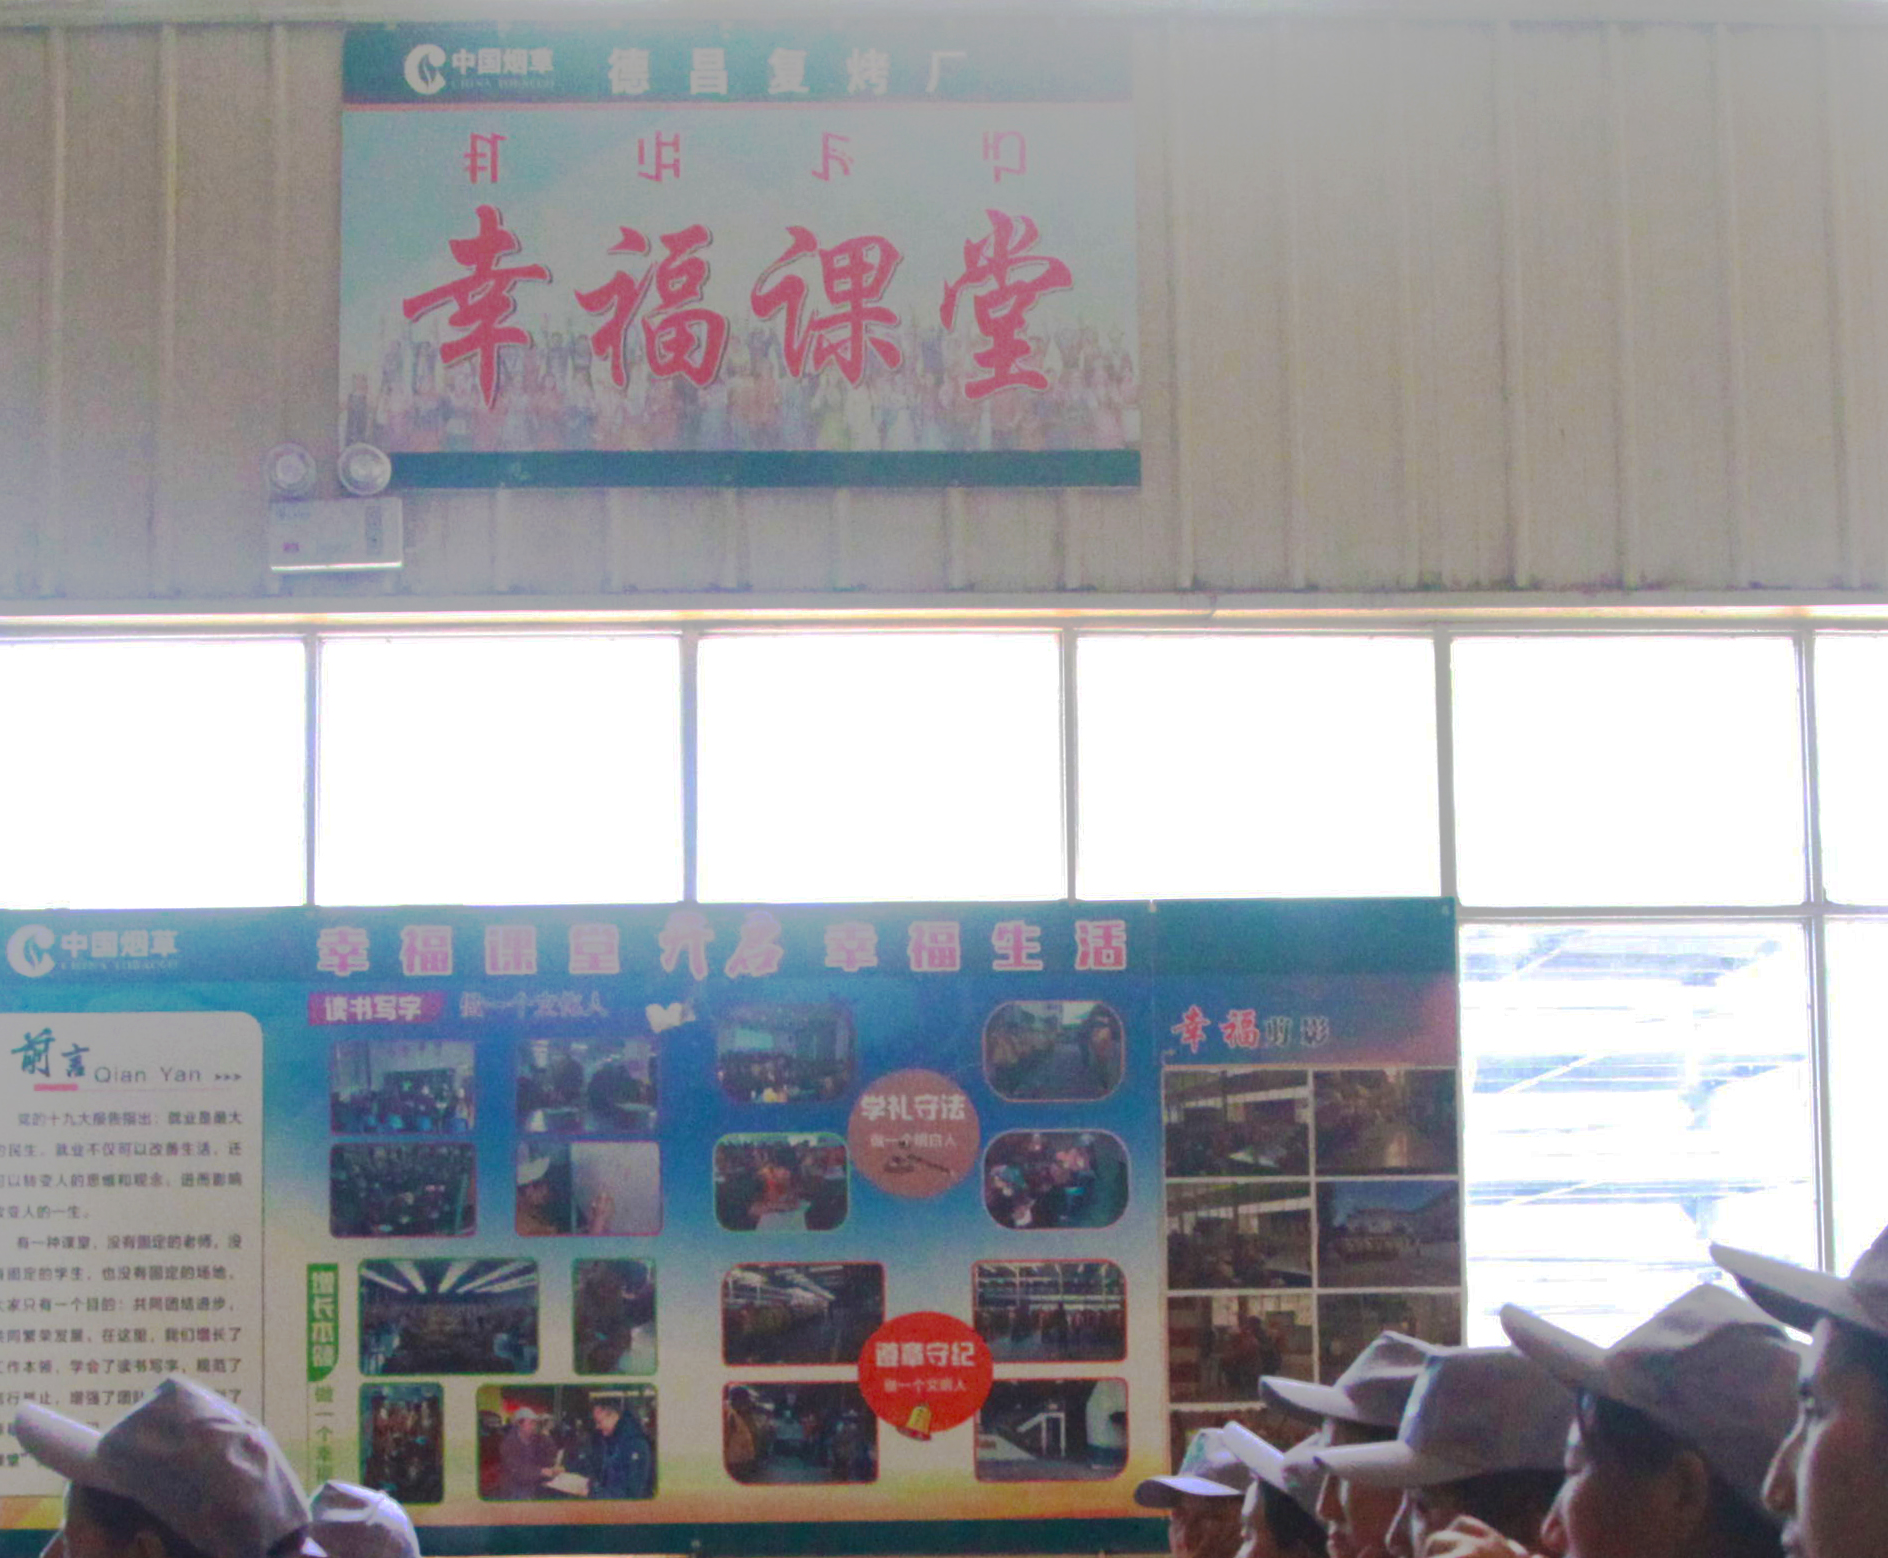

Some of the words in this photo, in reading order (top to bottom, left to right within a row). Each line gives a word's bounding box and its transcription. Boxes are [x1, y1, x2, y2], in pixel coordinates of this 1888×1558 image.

[452, 47, 554, 75] 中国烟草
[608, 47, 967, 97] 德昌复烤厂
[402, 204, 1073, 408] 幸福课堂
[61, 930, 179, 958] 中国烟草
[316, 909, 1128, 981] 幸福课堂开启幸福生活
[324, 995, 423, 1021] 读书写字
[1171, 1004, 1330, 1055] 幸福剪影
[10, 1026, 91, 1079] 前言
[94, 1066, 147, 1084] Qian
[159, 1066, 203, 1083] Yan
[860, 1095, 966, 1122] 学礼守法
[875, 1342, 976, 1368] 遵章守纪
